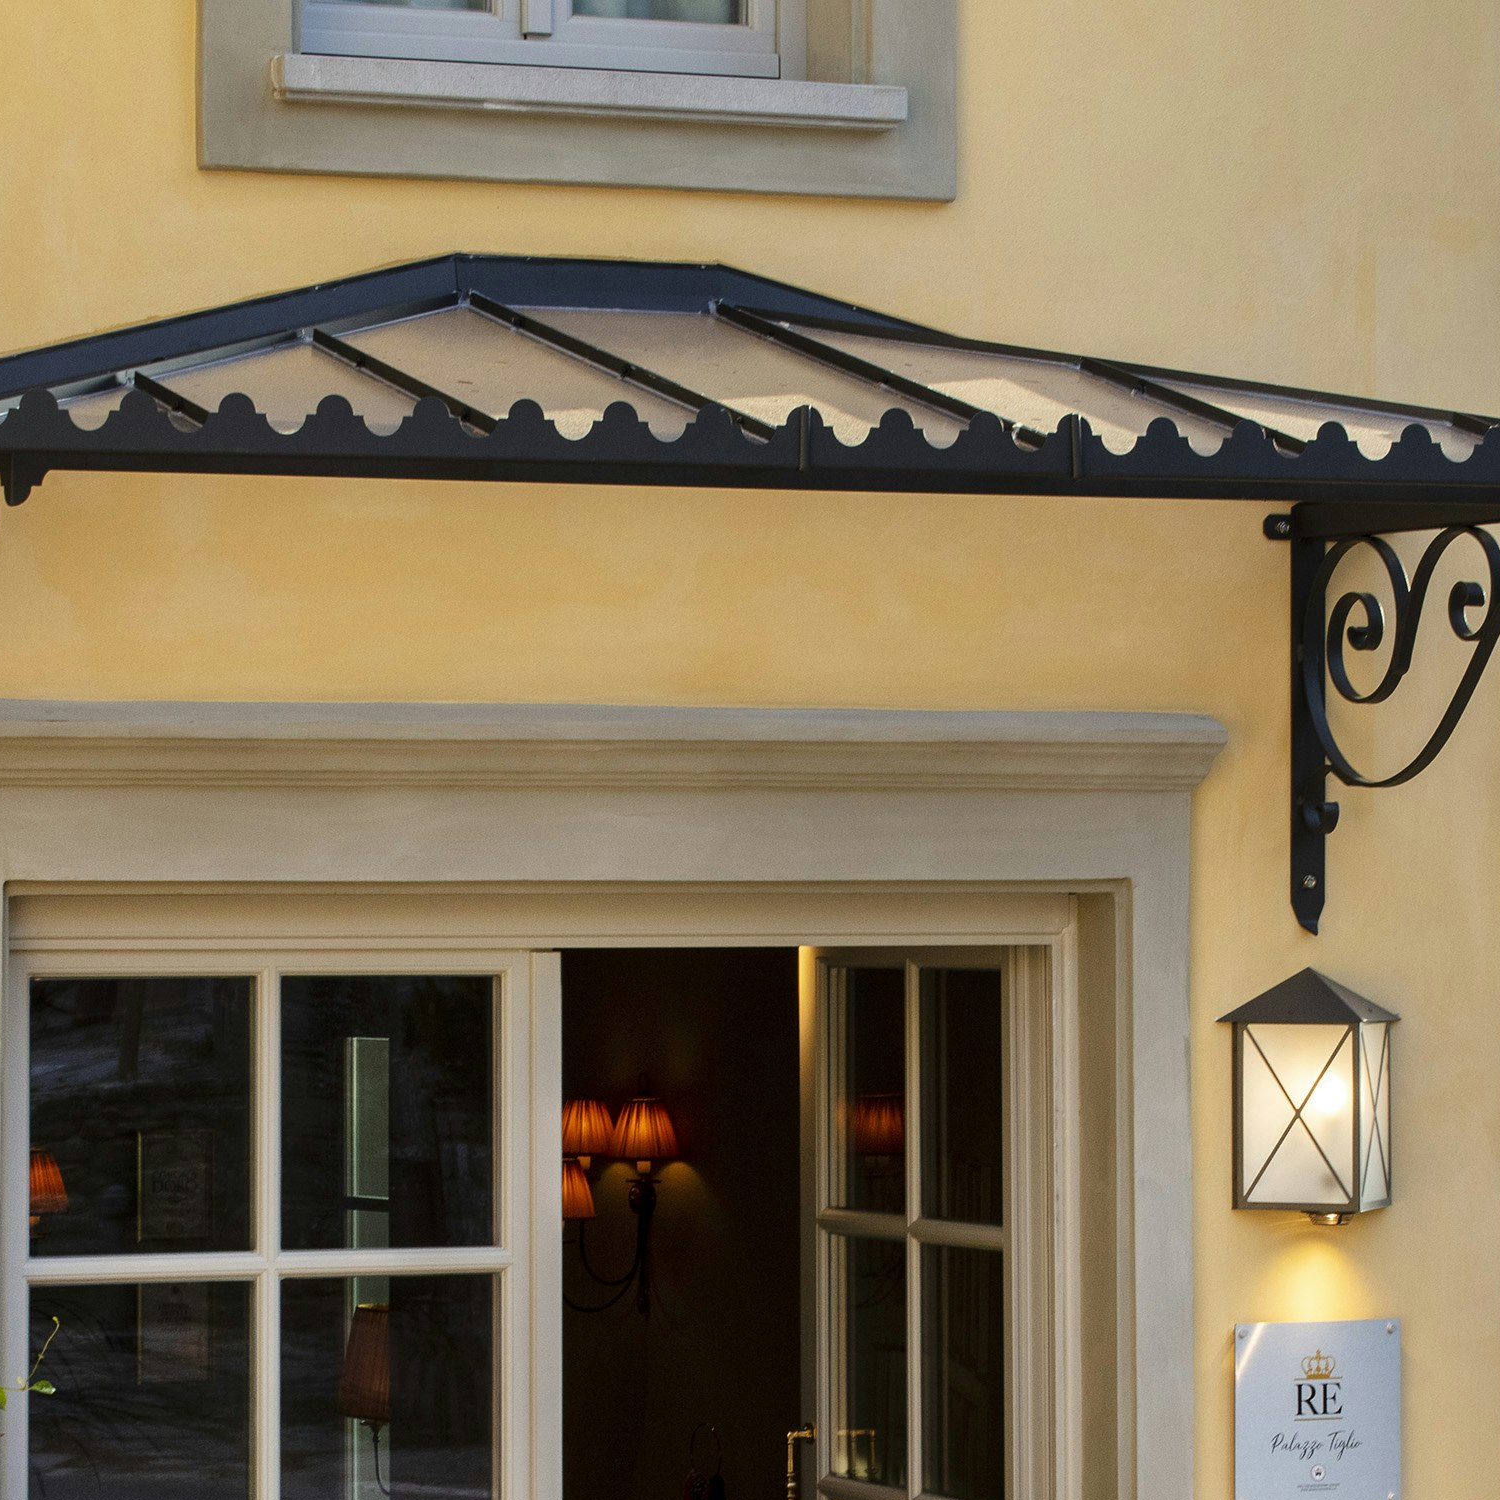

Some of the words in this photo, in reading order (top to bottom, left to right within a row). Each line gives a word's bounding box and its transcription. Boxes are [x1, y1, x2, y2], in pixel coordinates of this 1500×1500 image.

[1296, 1382, 1343, 1416] RE
[1271, 1432, 1323, 1460] Palazzo
[1327, 1430, 1363, 1461] Tiglio
